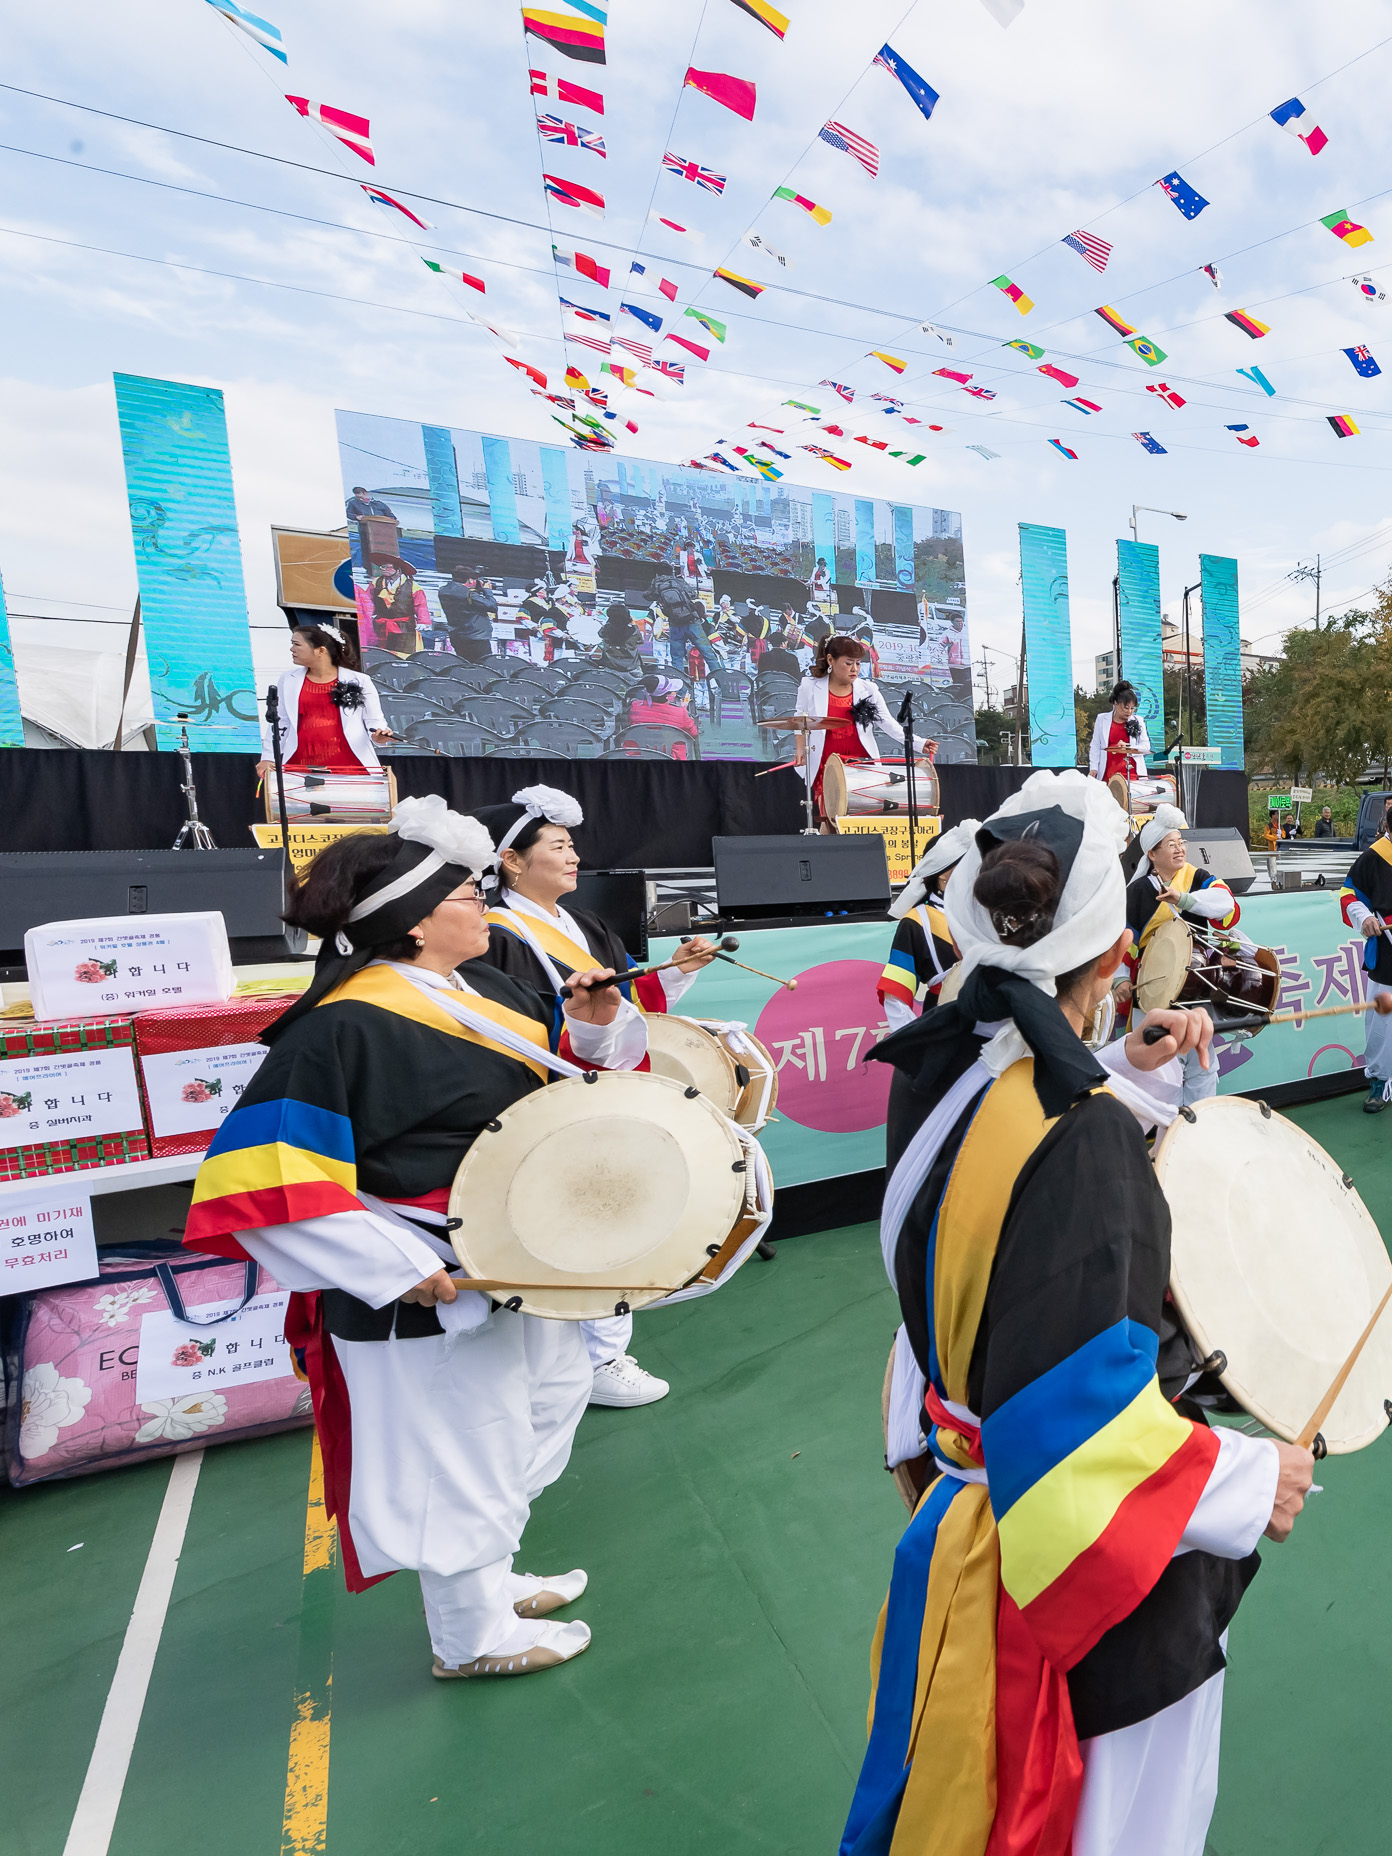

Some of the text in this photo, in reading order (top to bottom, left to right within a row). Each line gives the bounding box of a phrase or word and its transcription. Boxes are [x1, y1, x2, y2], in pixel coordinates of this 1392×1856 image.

[894, 853, 923, 862] Sprng
[1274, 940, 1368, 1029] 축제
[36, 1206, 83, 1223] 미기재
[11, 1227, 74, 1248] 호명하여
[4, 1248, 68, 1269] 무효처리
